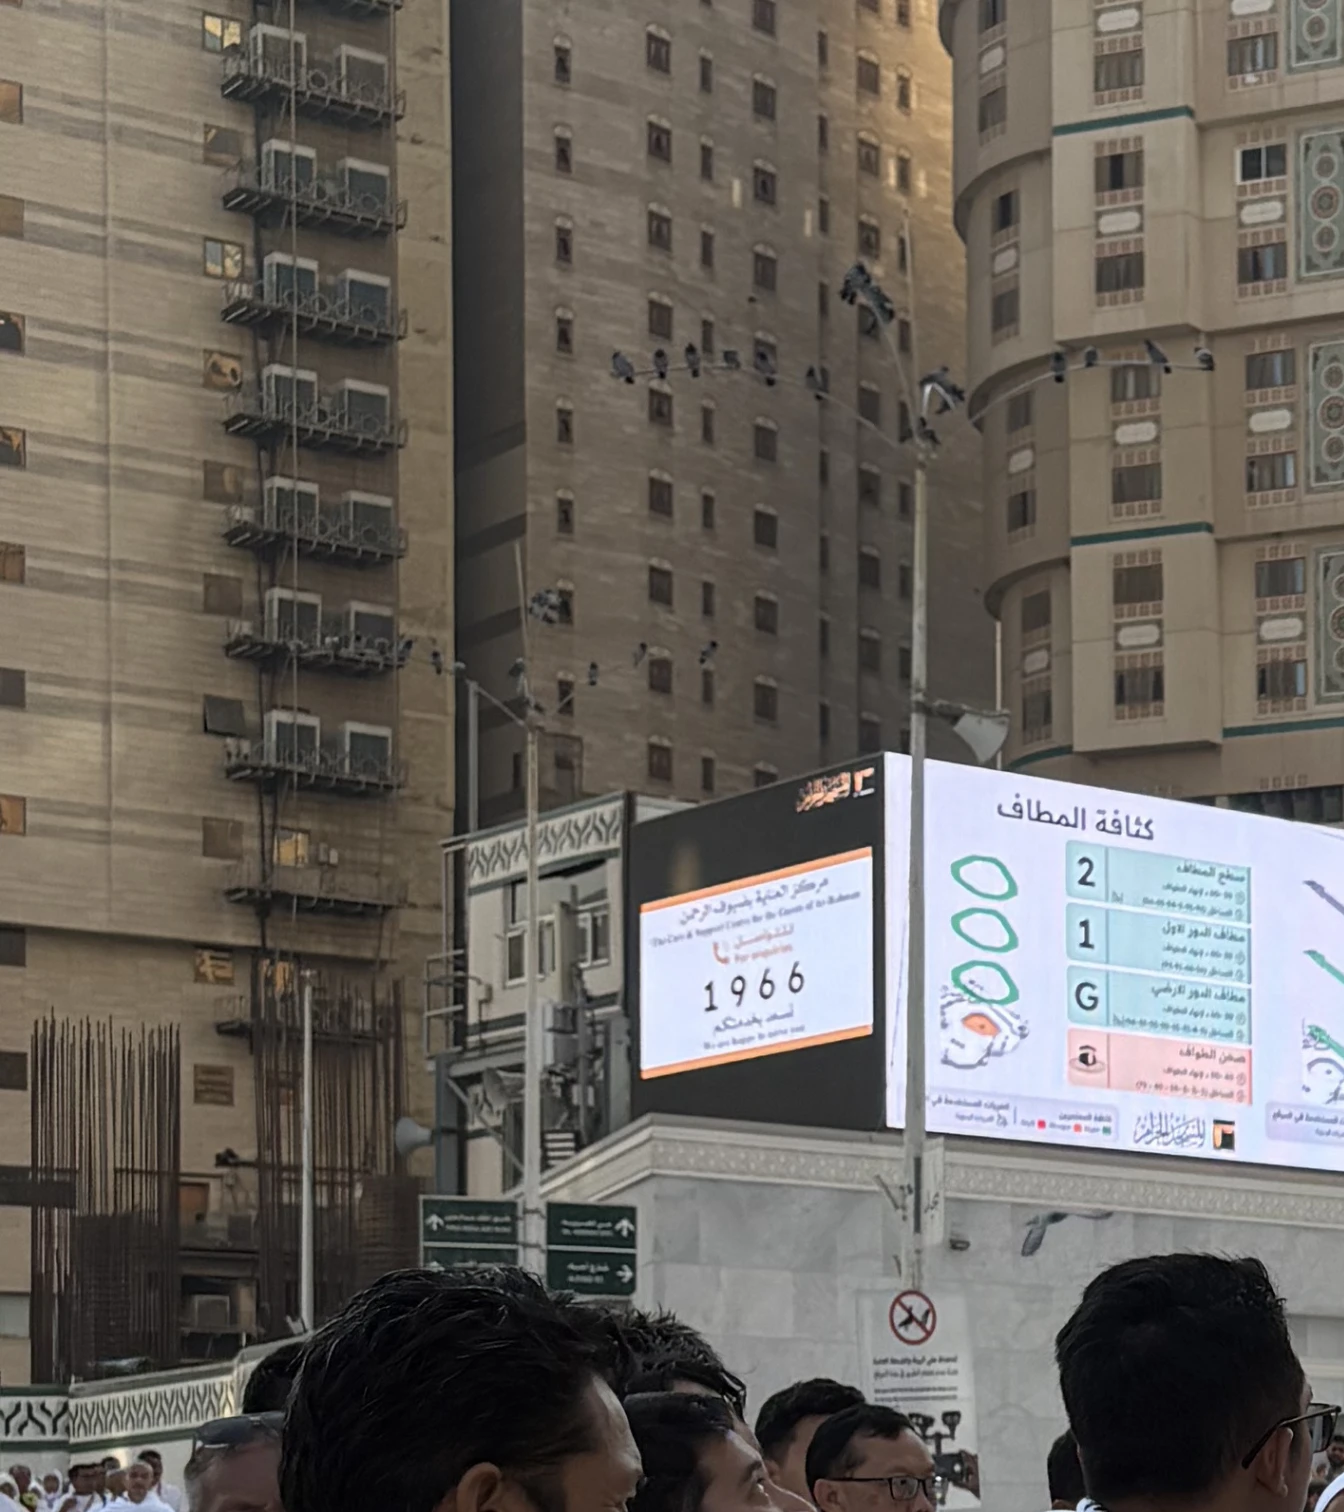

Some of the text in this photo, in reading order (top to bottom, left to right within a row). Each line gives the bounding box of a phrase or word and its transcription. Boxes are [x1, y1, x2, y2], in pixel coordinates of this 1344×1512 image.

[996, 793, 1155, 841] كثافة المطاف
[1077, 857, 1096, 887] 2
[1078, 919, 1096, 950] 1
[704, 961, 806, 1012] 1966
[1075, 981, 1099, 1012] G
